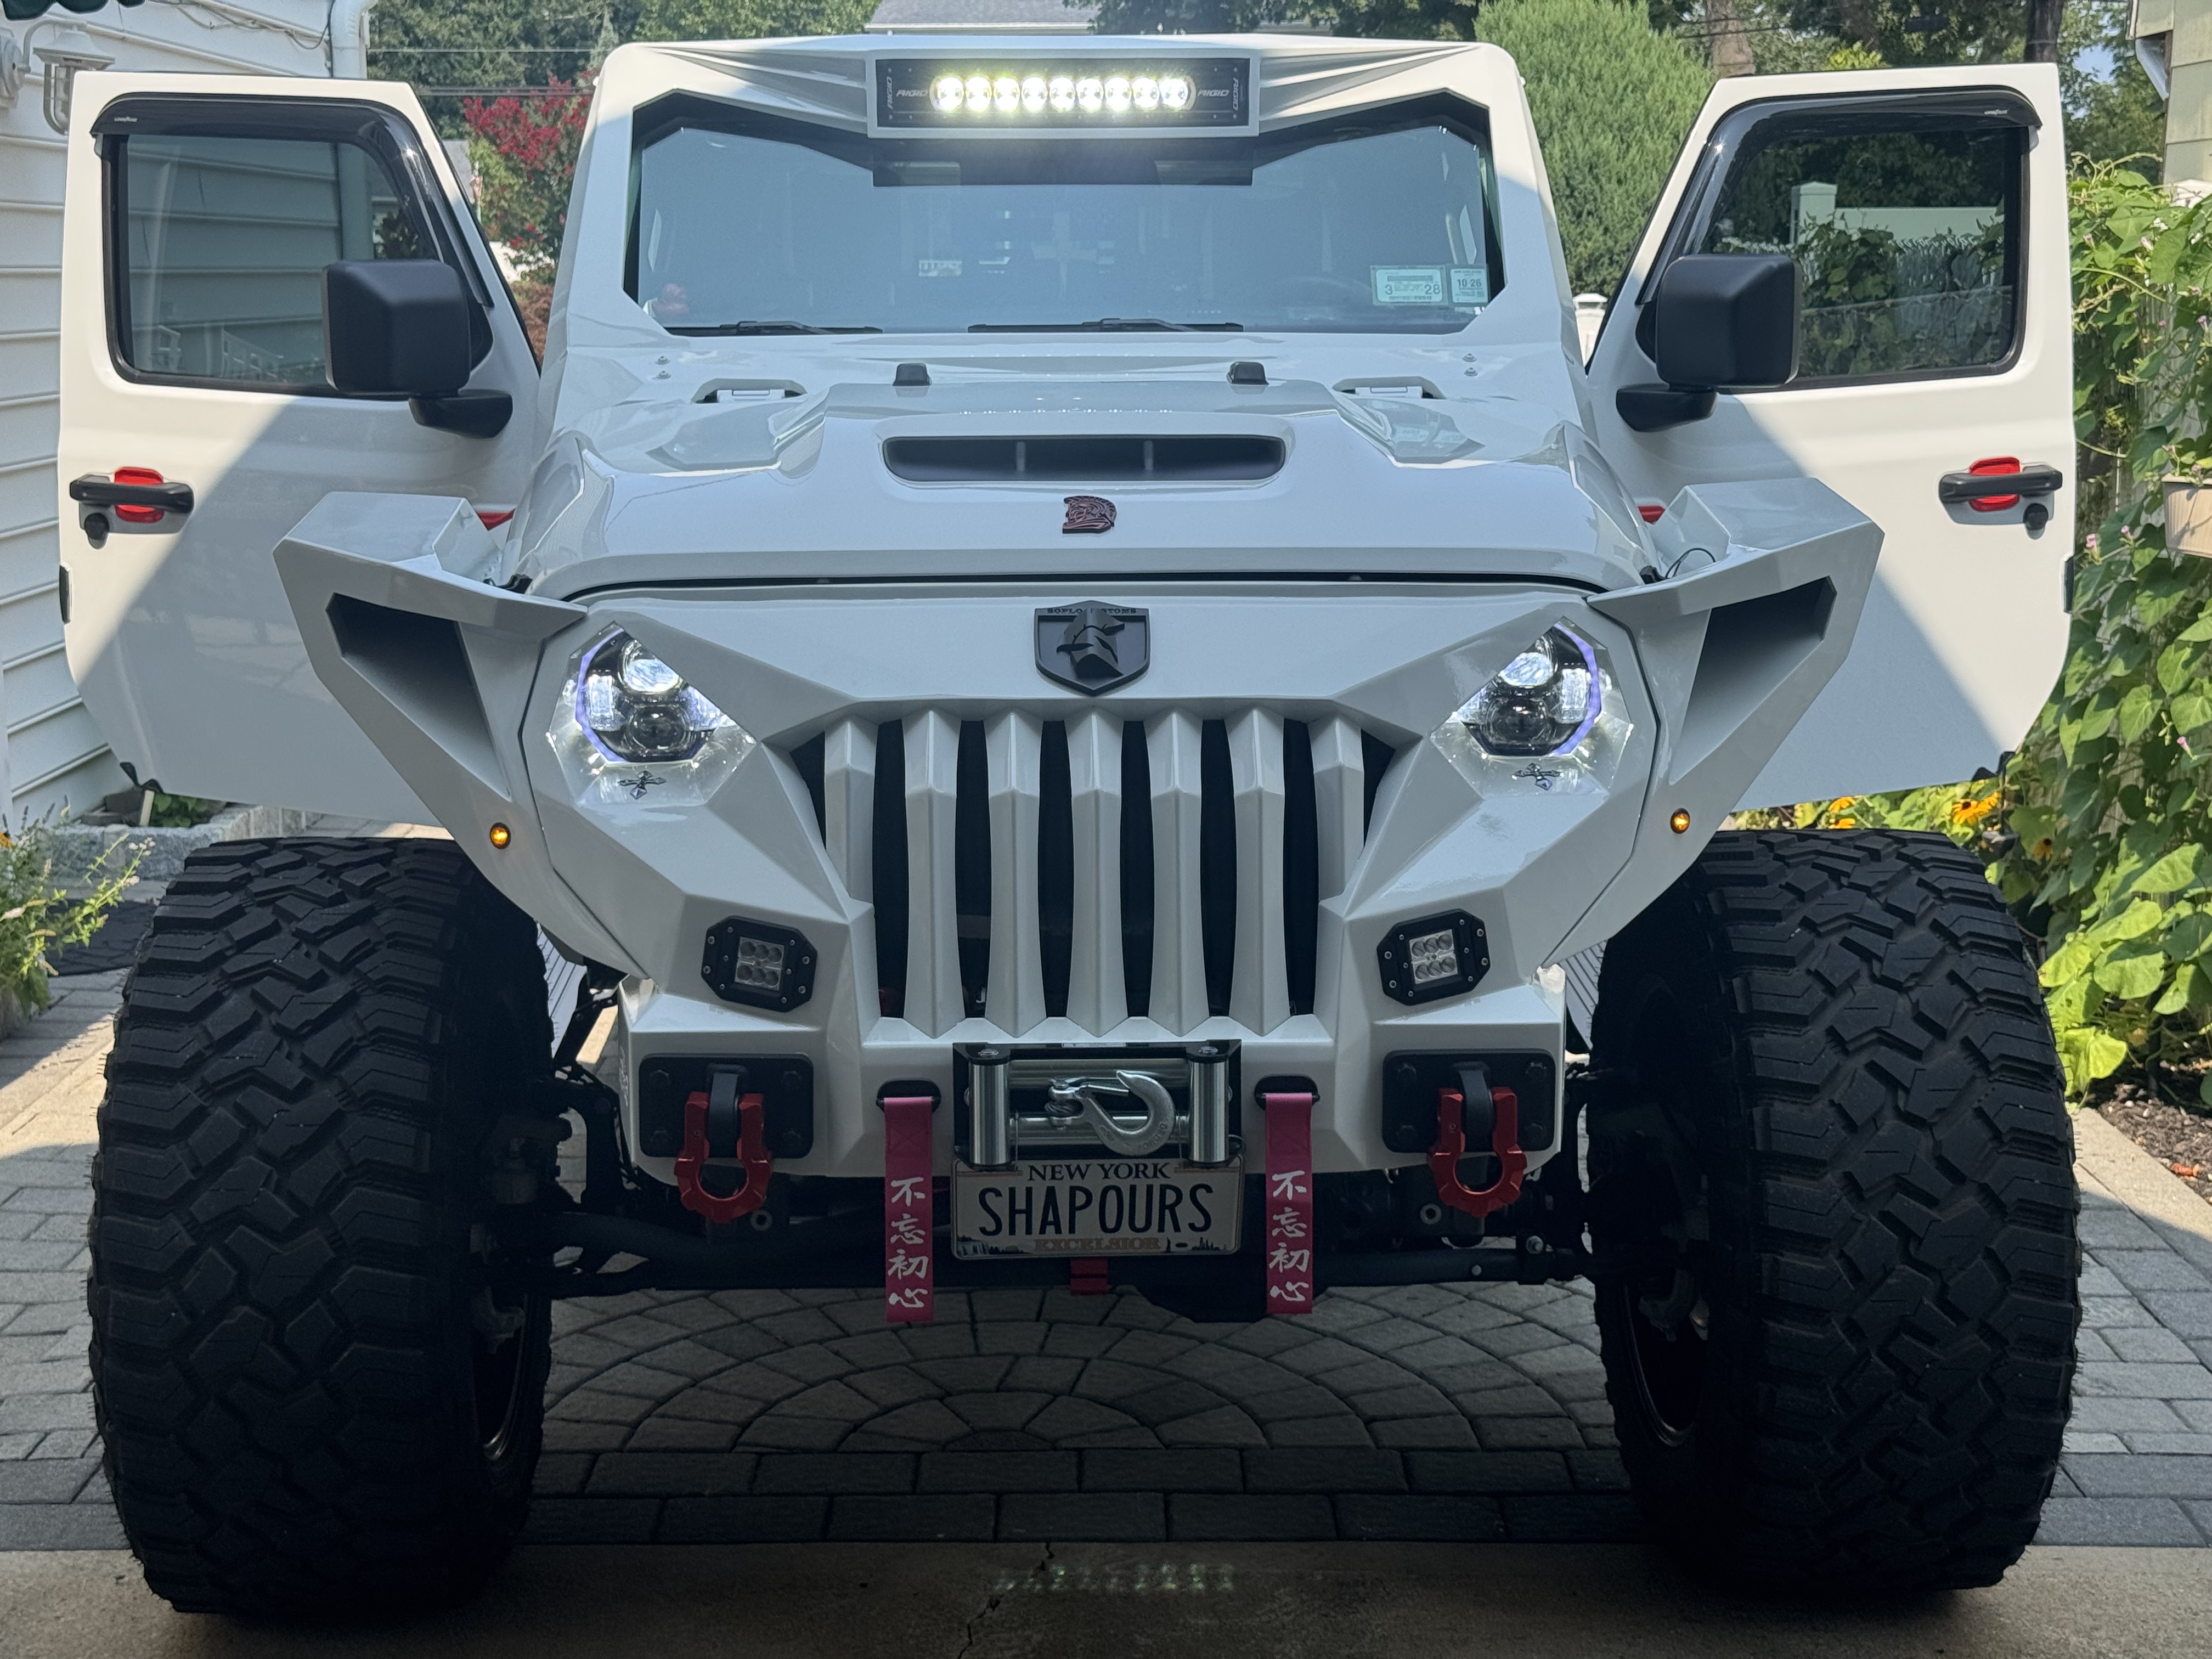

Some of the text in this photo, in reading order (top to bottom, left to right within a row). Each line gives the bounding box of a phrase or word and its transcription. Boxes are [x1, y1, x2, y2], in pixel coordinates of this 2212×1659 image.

[1385, 284, 1393, 295] 3
[1425, 284, 1441, 295] 28
[1028, 1162, 1171, 1181] NEW YORK
[978, 1183, 1214, 1236] SHAPOURS
[888, 1177, 929, 1308] 不忘初心
[1034, 1237, 1161, 1252] EXCELSIOR
[1269, 1170, 1310, 1302] 不忘初心
